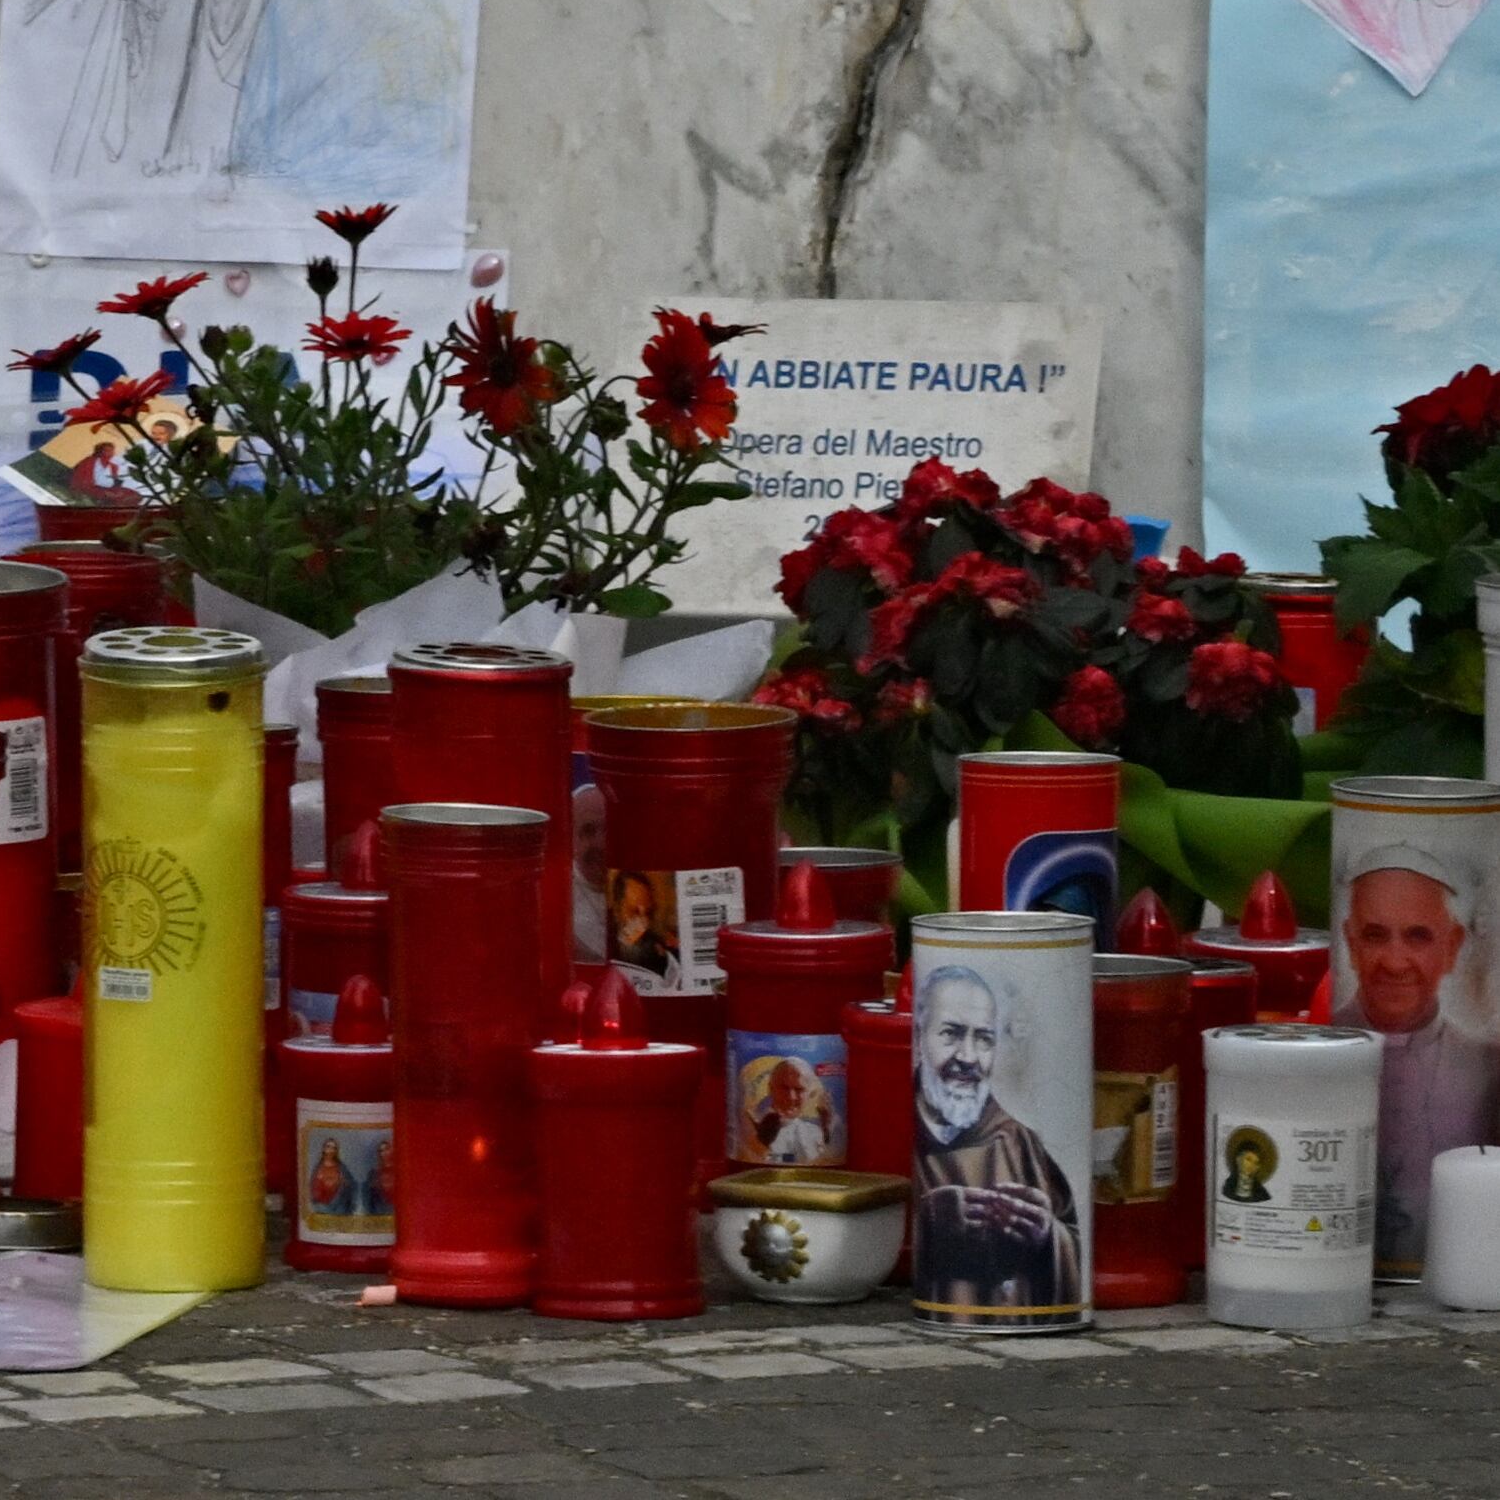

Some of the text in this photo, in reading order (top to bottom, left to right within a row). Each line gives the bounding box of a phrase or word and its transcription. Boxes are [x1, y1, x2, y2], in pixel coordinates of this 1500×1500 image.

[748, 360, 898, 390] ABBIATE
[908, 362, 1028, 393] PAURA
[812, 428, 856, 456] del
[867, 429, 983, 458] Maestro
[735, 470, 844, 501] Stefano
[1298, 1140, 1343, 1163] 30T
